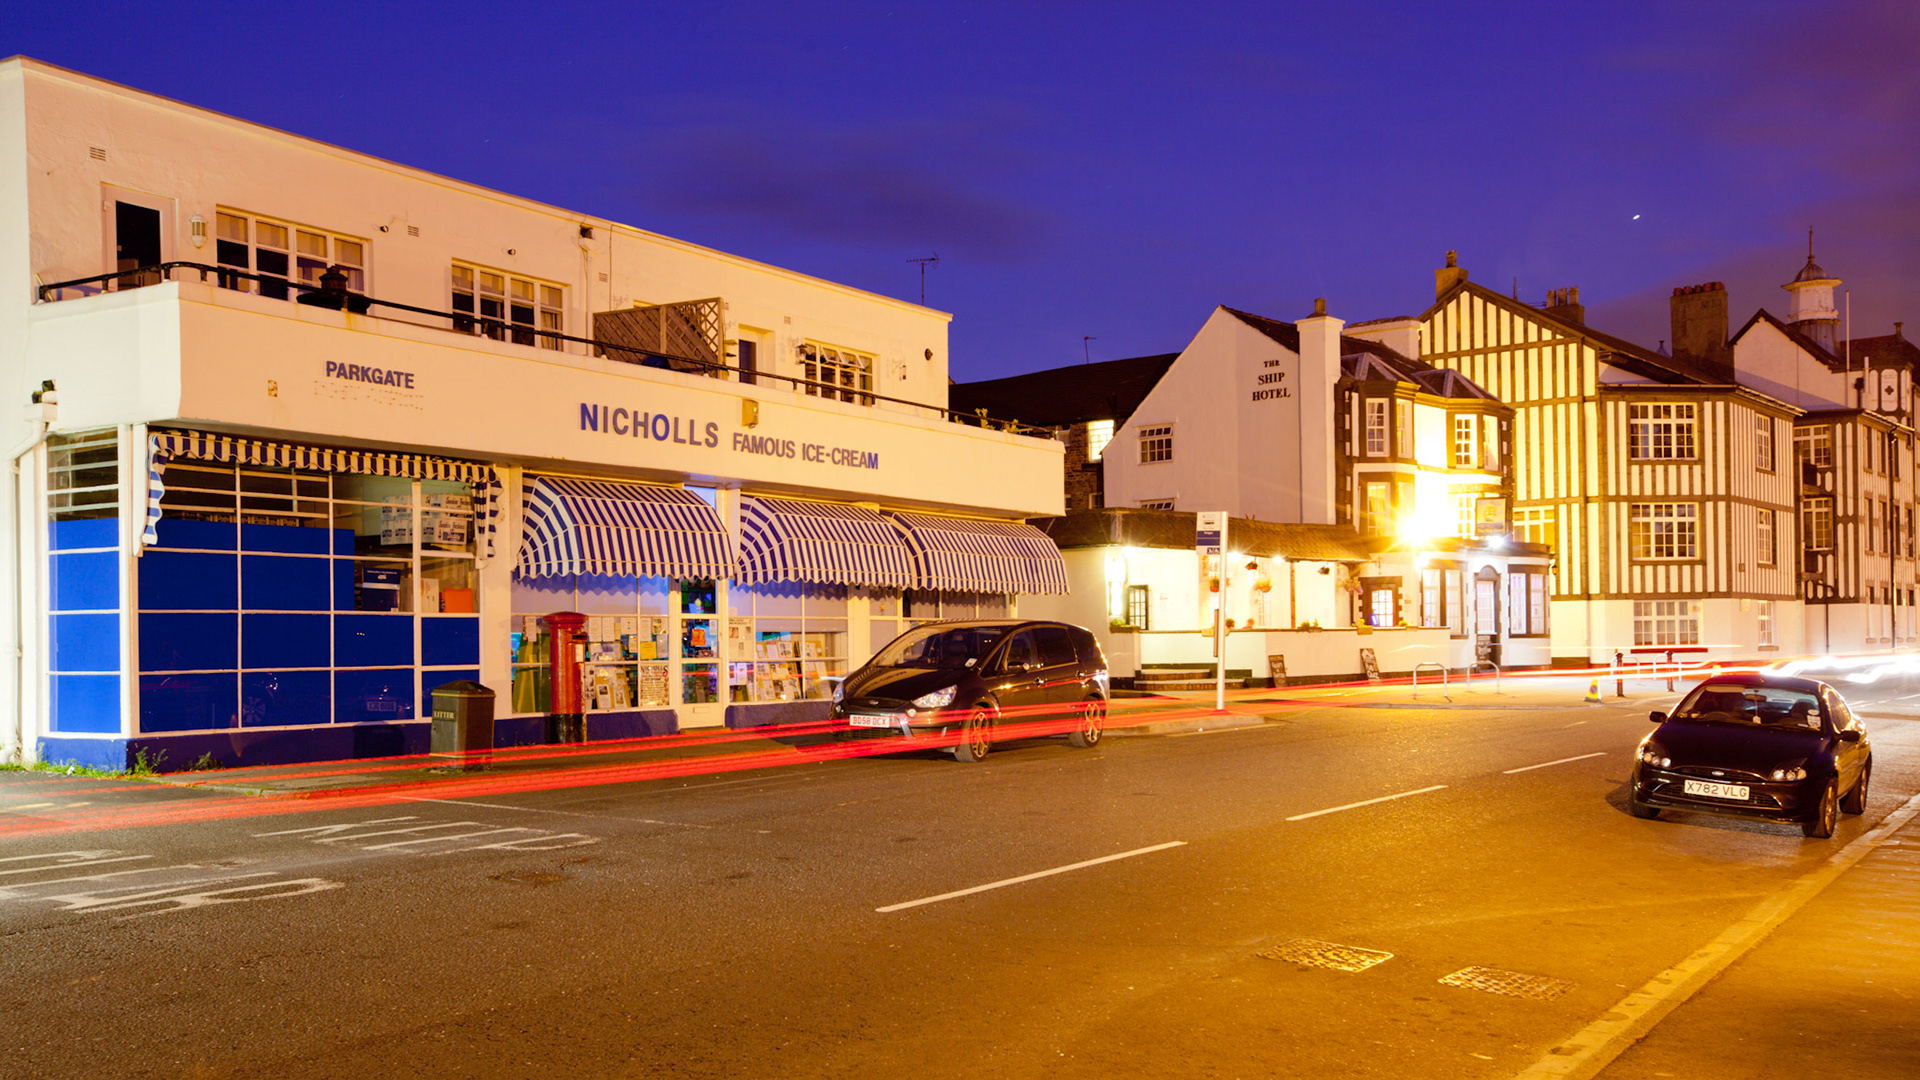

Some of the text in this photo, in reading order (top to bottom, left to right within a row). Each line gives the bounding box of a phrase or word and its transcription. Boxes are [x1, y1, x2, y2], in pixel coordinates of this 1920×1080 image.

[1263, 359, 1281, 368] THE
[326, 360, 415, 389] PARKGATE
[1258, 372, 1285, 385] SHIP
[1252, 387, 1291, 401] HOTEL
[580, 402, 879, 470] NICHOLLS FAMOUS ICE-CREAM
[434, 711, 454, 719] LITTER
[1687, 781, 1747, 798] X782 VLG
